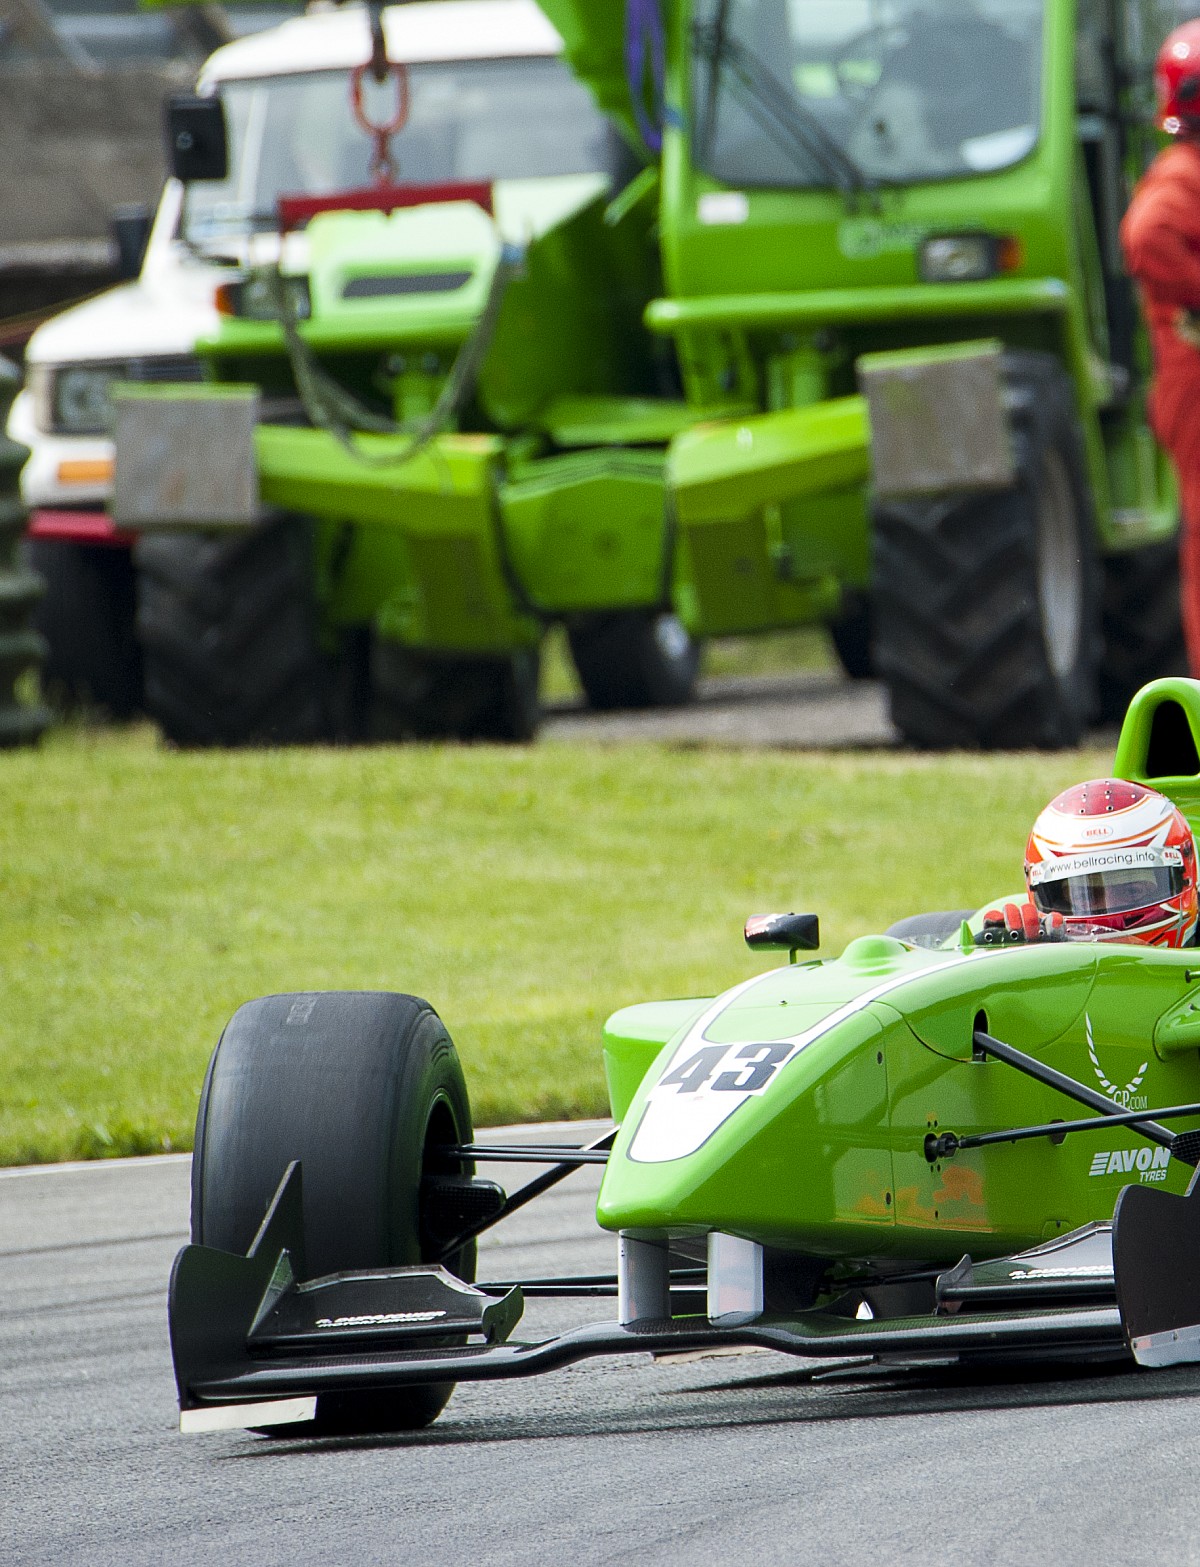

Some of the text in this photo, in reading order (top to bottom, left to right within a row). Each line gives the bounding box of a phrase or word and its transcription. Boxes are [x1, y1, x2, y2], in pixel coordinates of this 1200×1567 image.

[1086, 829, 1109, 837] BELL
[1049, 852, 1156, 874] www.bellracing.info
[1164, 851, 1180, 859] BELL
[658, 1043, 796, 1095] 43
[1106, 1146, 1172, 1175] AVON
[1140, 1169, 1168, 1183] TYRES
